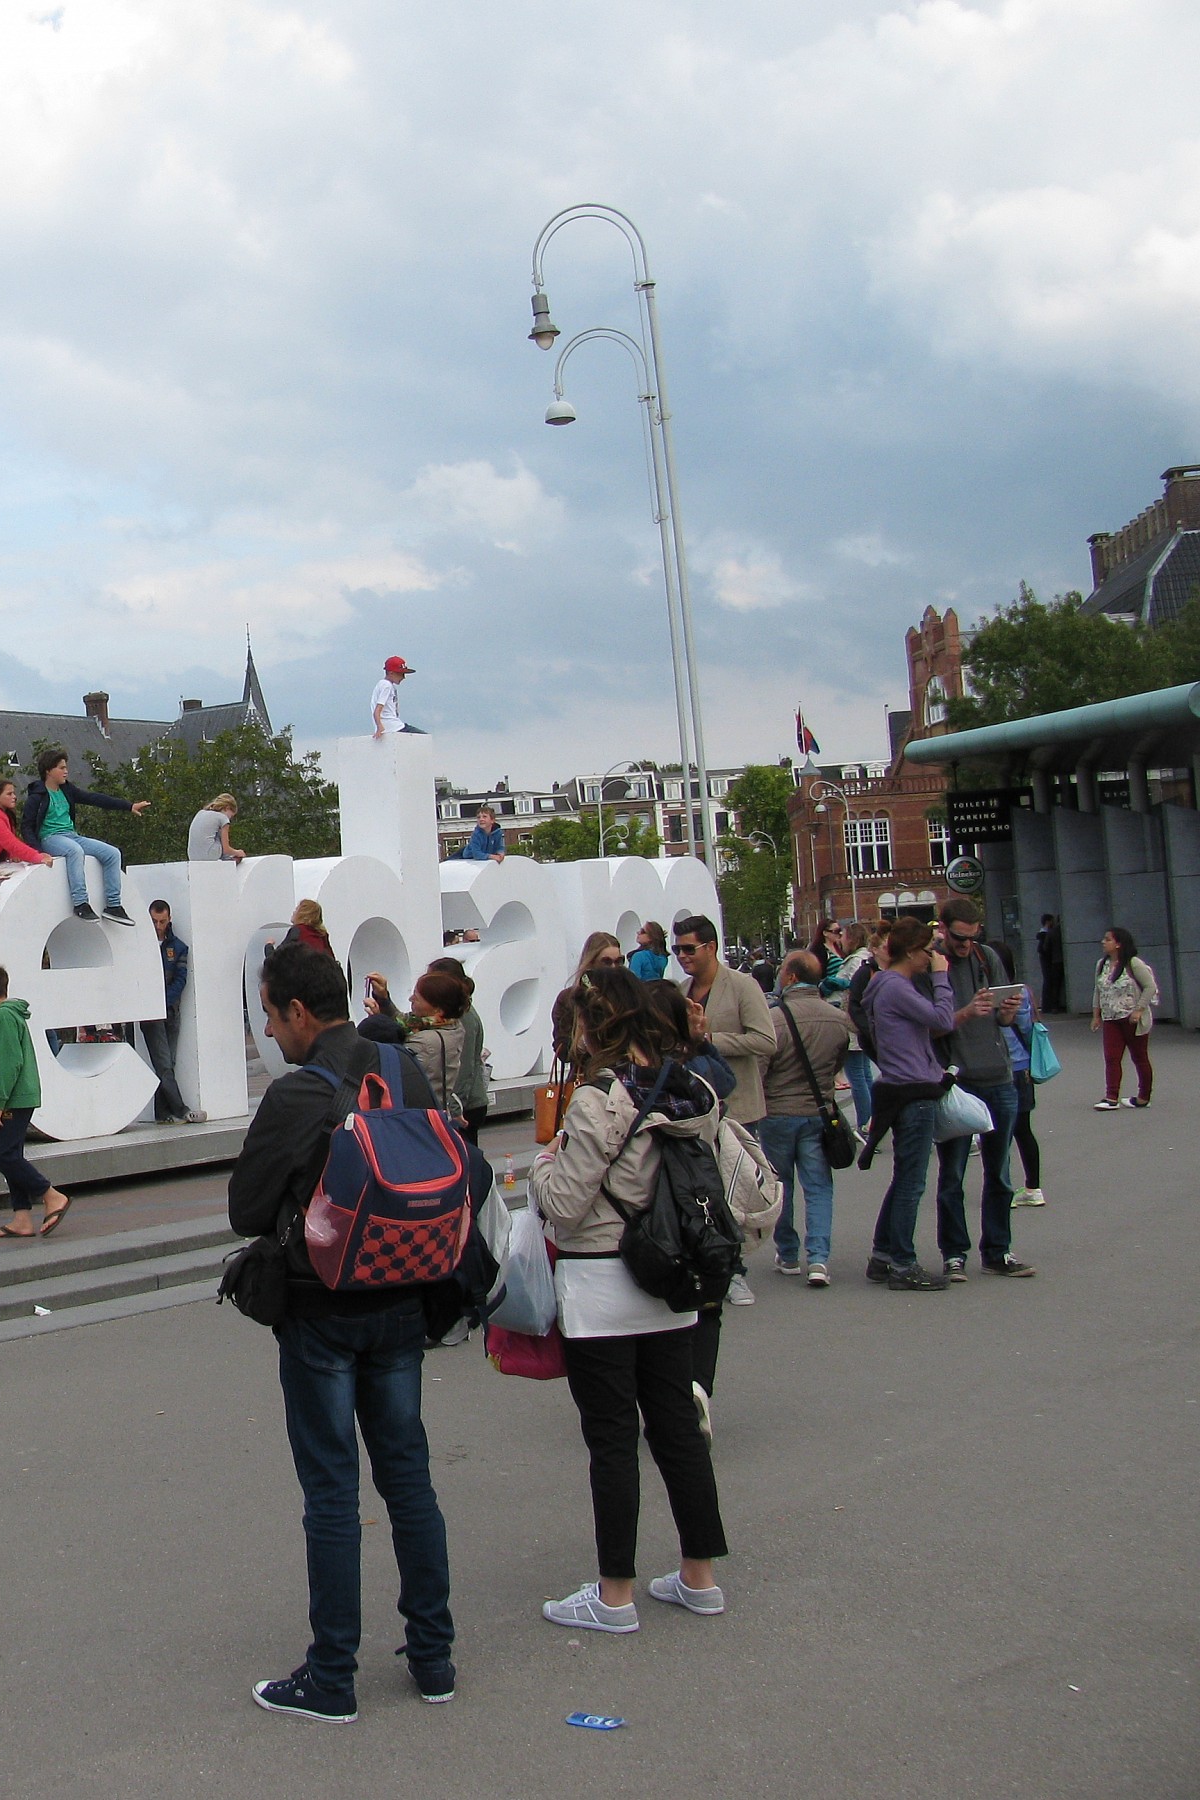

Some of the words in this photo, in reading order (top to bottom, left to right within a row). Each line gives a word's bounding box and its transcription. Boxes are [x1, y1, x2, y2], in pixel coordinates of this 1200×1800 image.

[953, 801, 985, 809] TOILET
[953, 813, 996, 821] PARKING
[955, 826, 987, 834] COBRA
